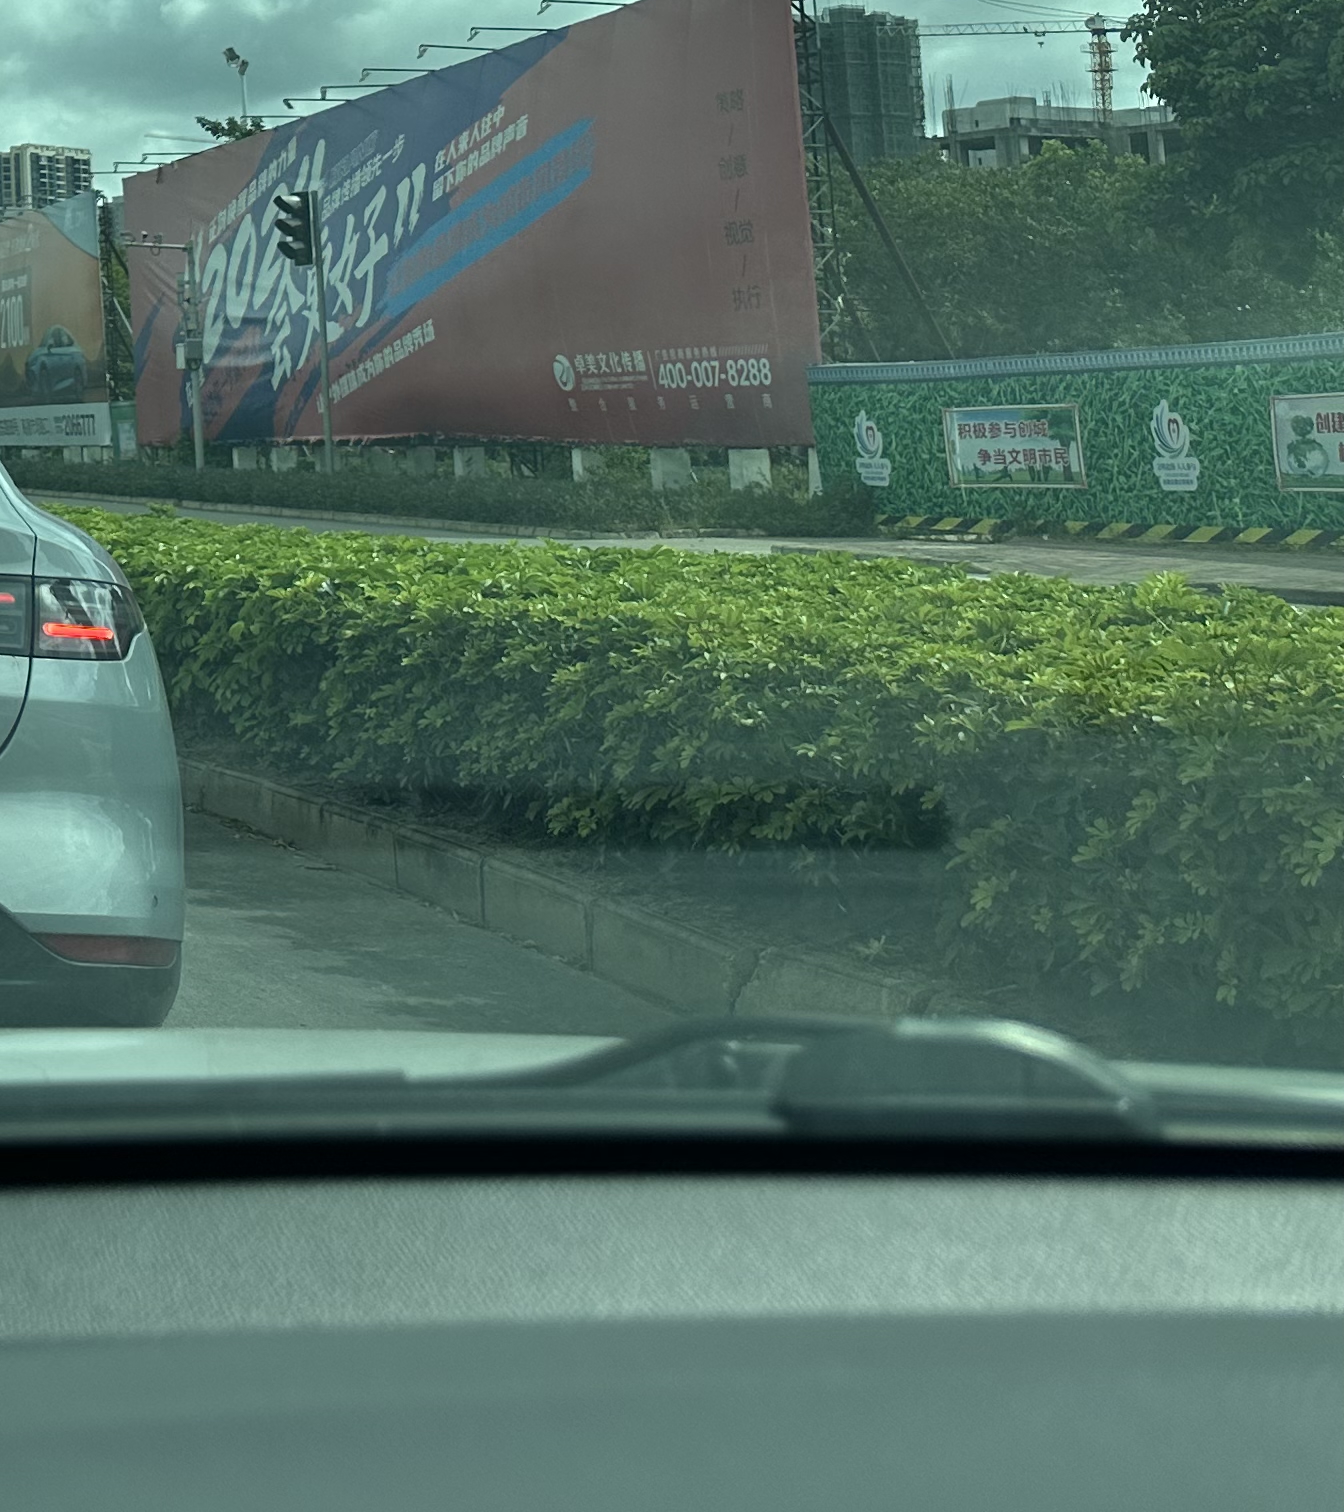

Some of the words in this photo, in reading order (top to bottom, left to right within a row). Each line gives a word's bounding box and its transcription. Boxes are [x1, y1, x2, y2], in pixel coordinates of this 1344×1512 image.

[574, 350, 647, 375] 卓美文化传播
[658, 358, 772, 389] 400-007-8288
[957, 420, 1049, 439] 积极参与创城
[977, 447, 1070, 466] 争当文明市民
